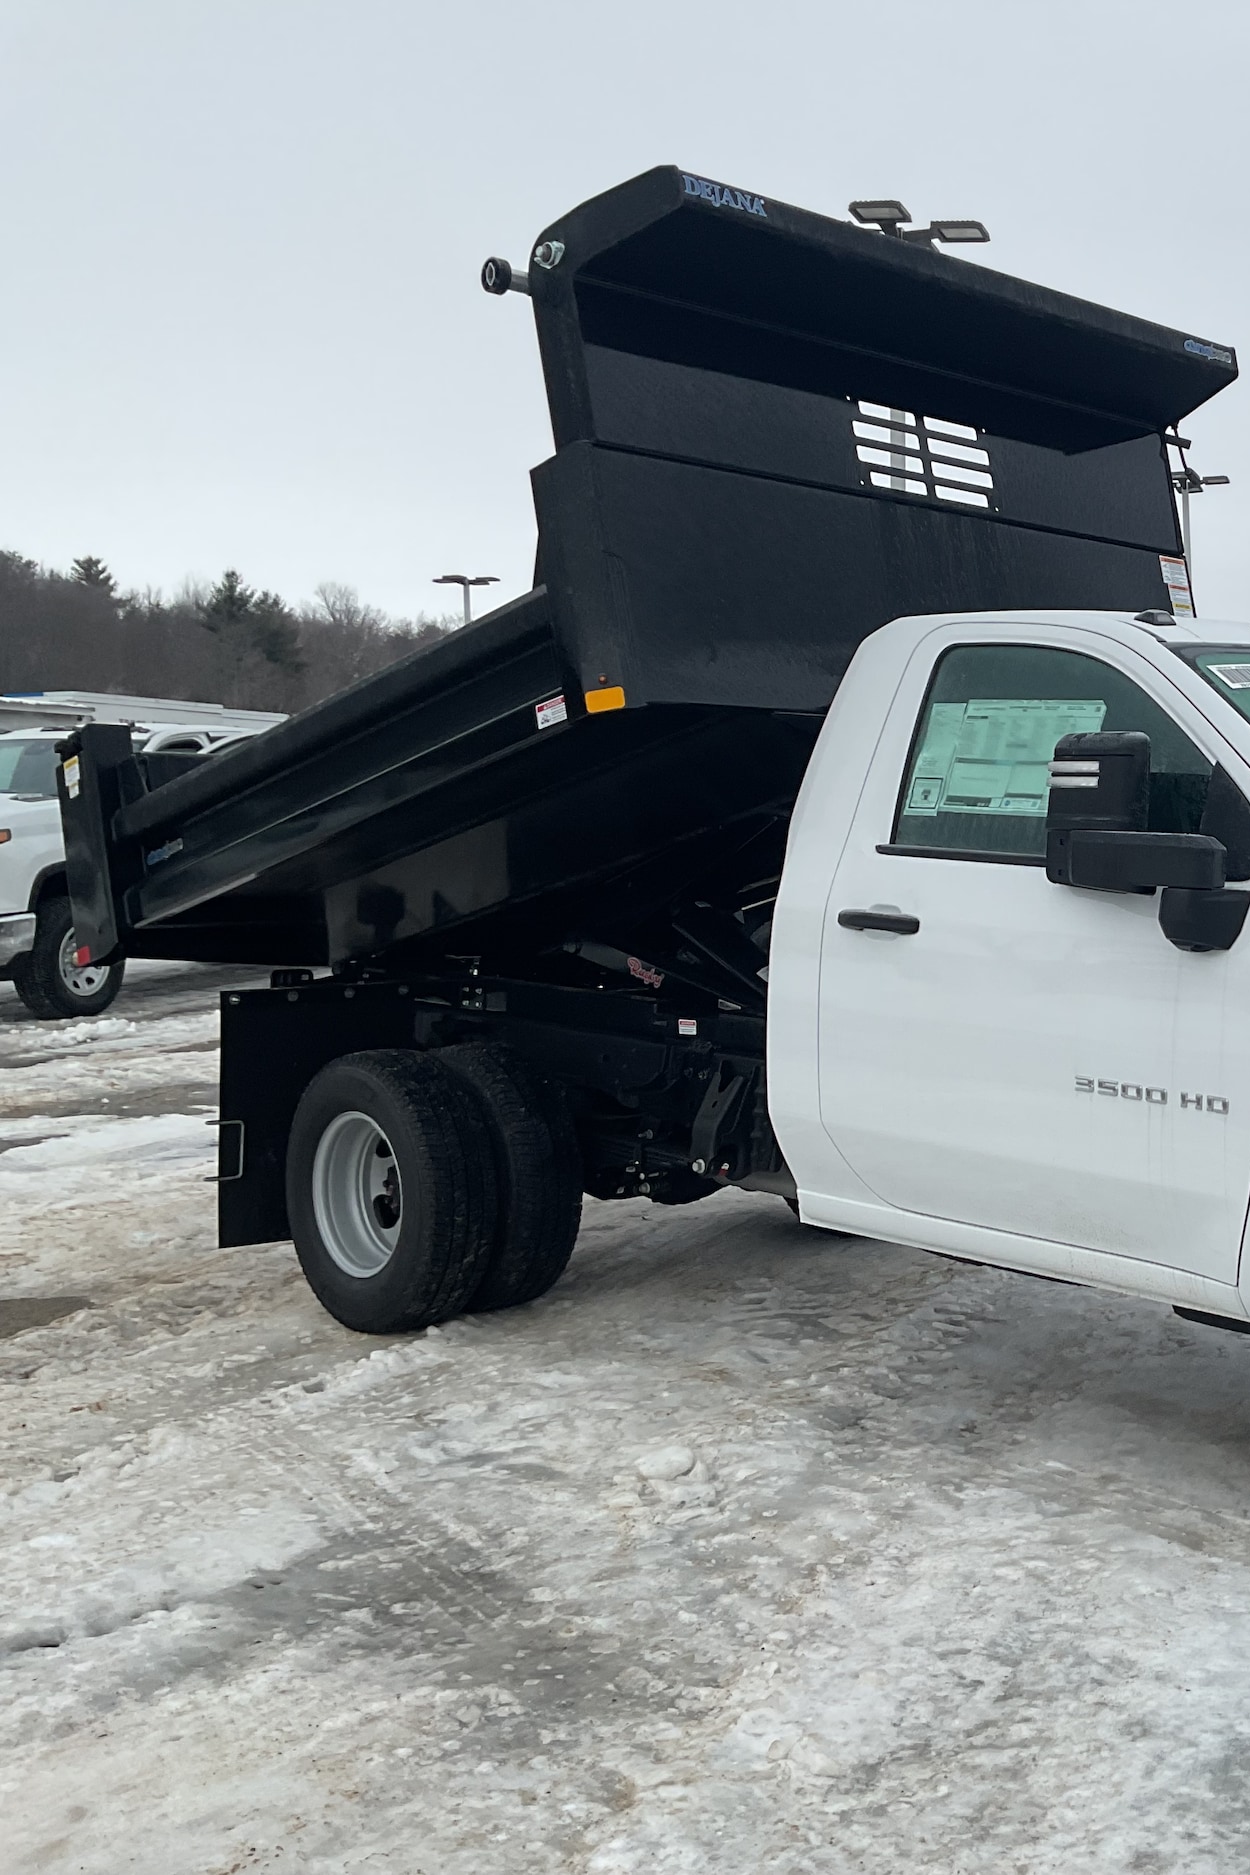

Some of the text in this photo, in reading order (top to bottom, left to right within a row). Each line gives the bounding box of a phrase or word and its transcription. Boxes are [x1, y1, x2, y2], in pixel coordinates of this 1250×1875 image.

[682, 175, 767, 217] DEJANA
[1075, 1074, 1230, 1115] 3500 HD
